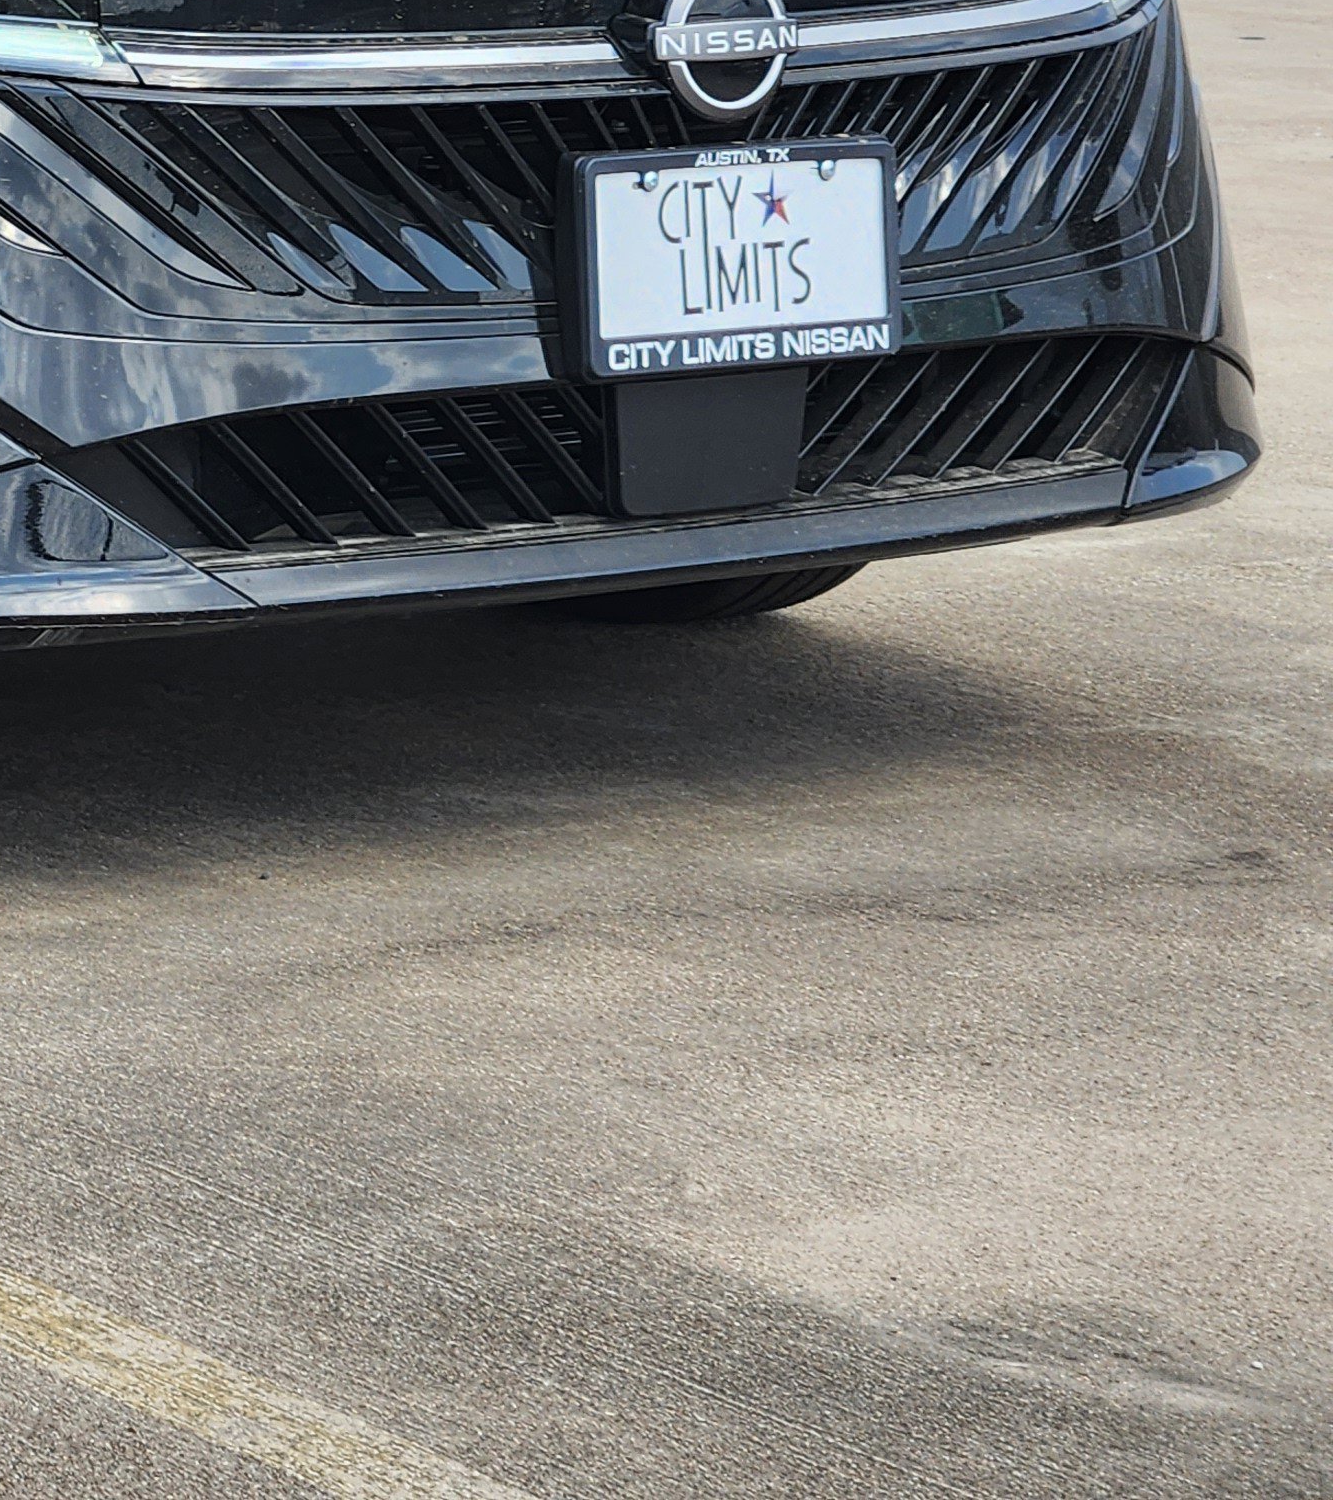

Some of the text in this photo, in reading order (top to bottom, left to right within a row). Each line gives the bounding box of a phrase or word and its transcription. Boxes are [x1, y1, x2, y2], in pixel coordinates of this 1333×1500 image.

[660, 25, 797, 56] NISSAN
[694, 147, 791, 168] AUSTIN, TX
[679, 238, 811, 315] LIMITS
[608, 324, 890, 372] CITY LIMITS NISSAN
